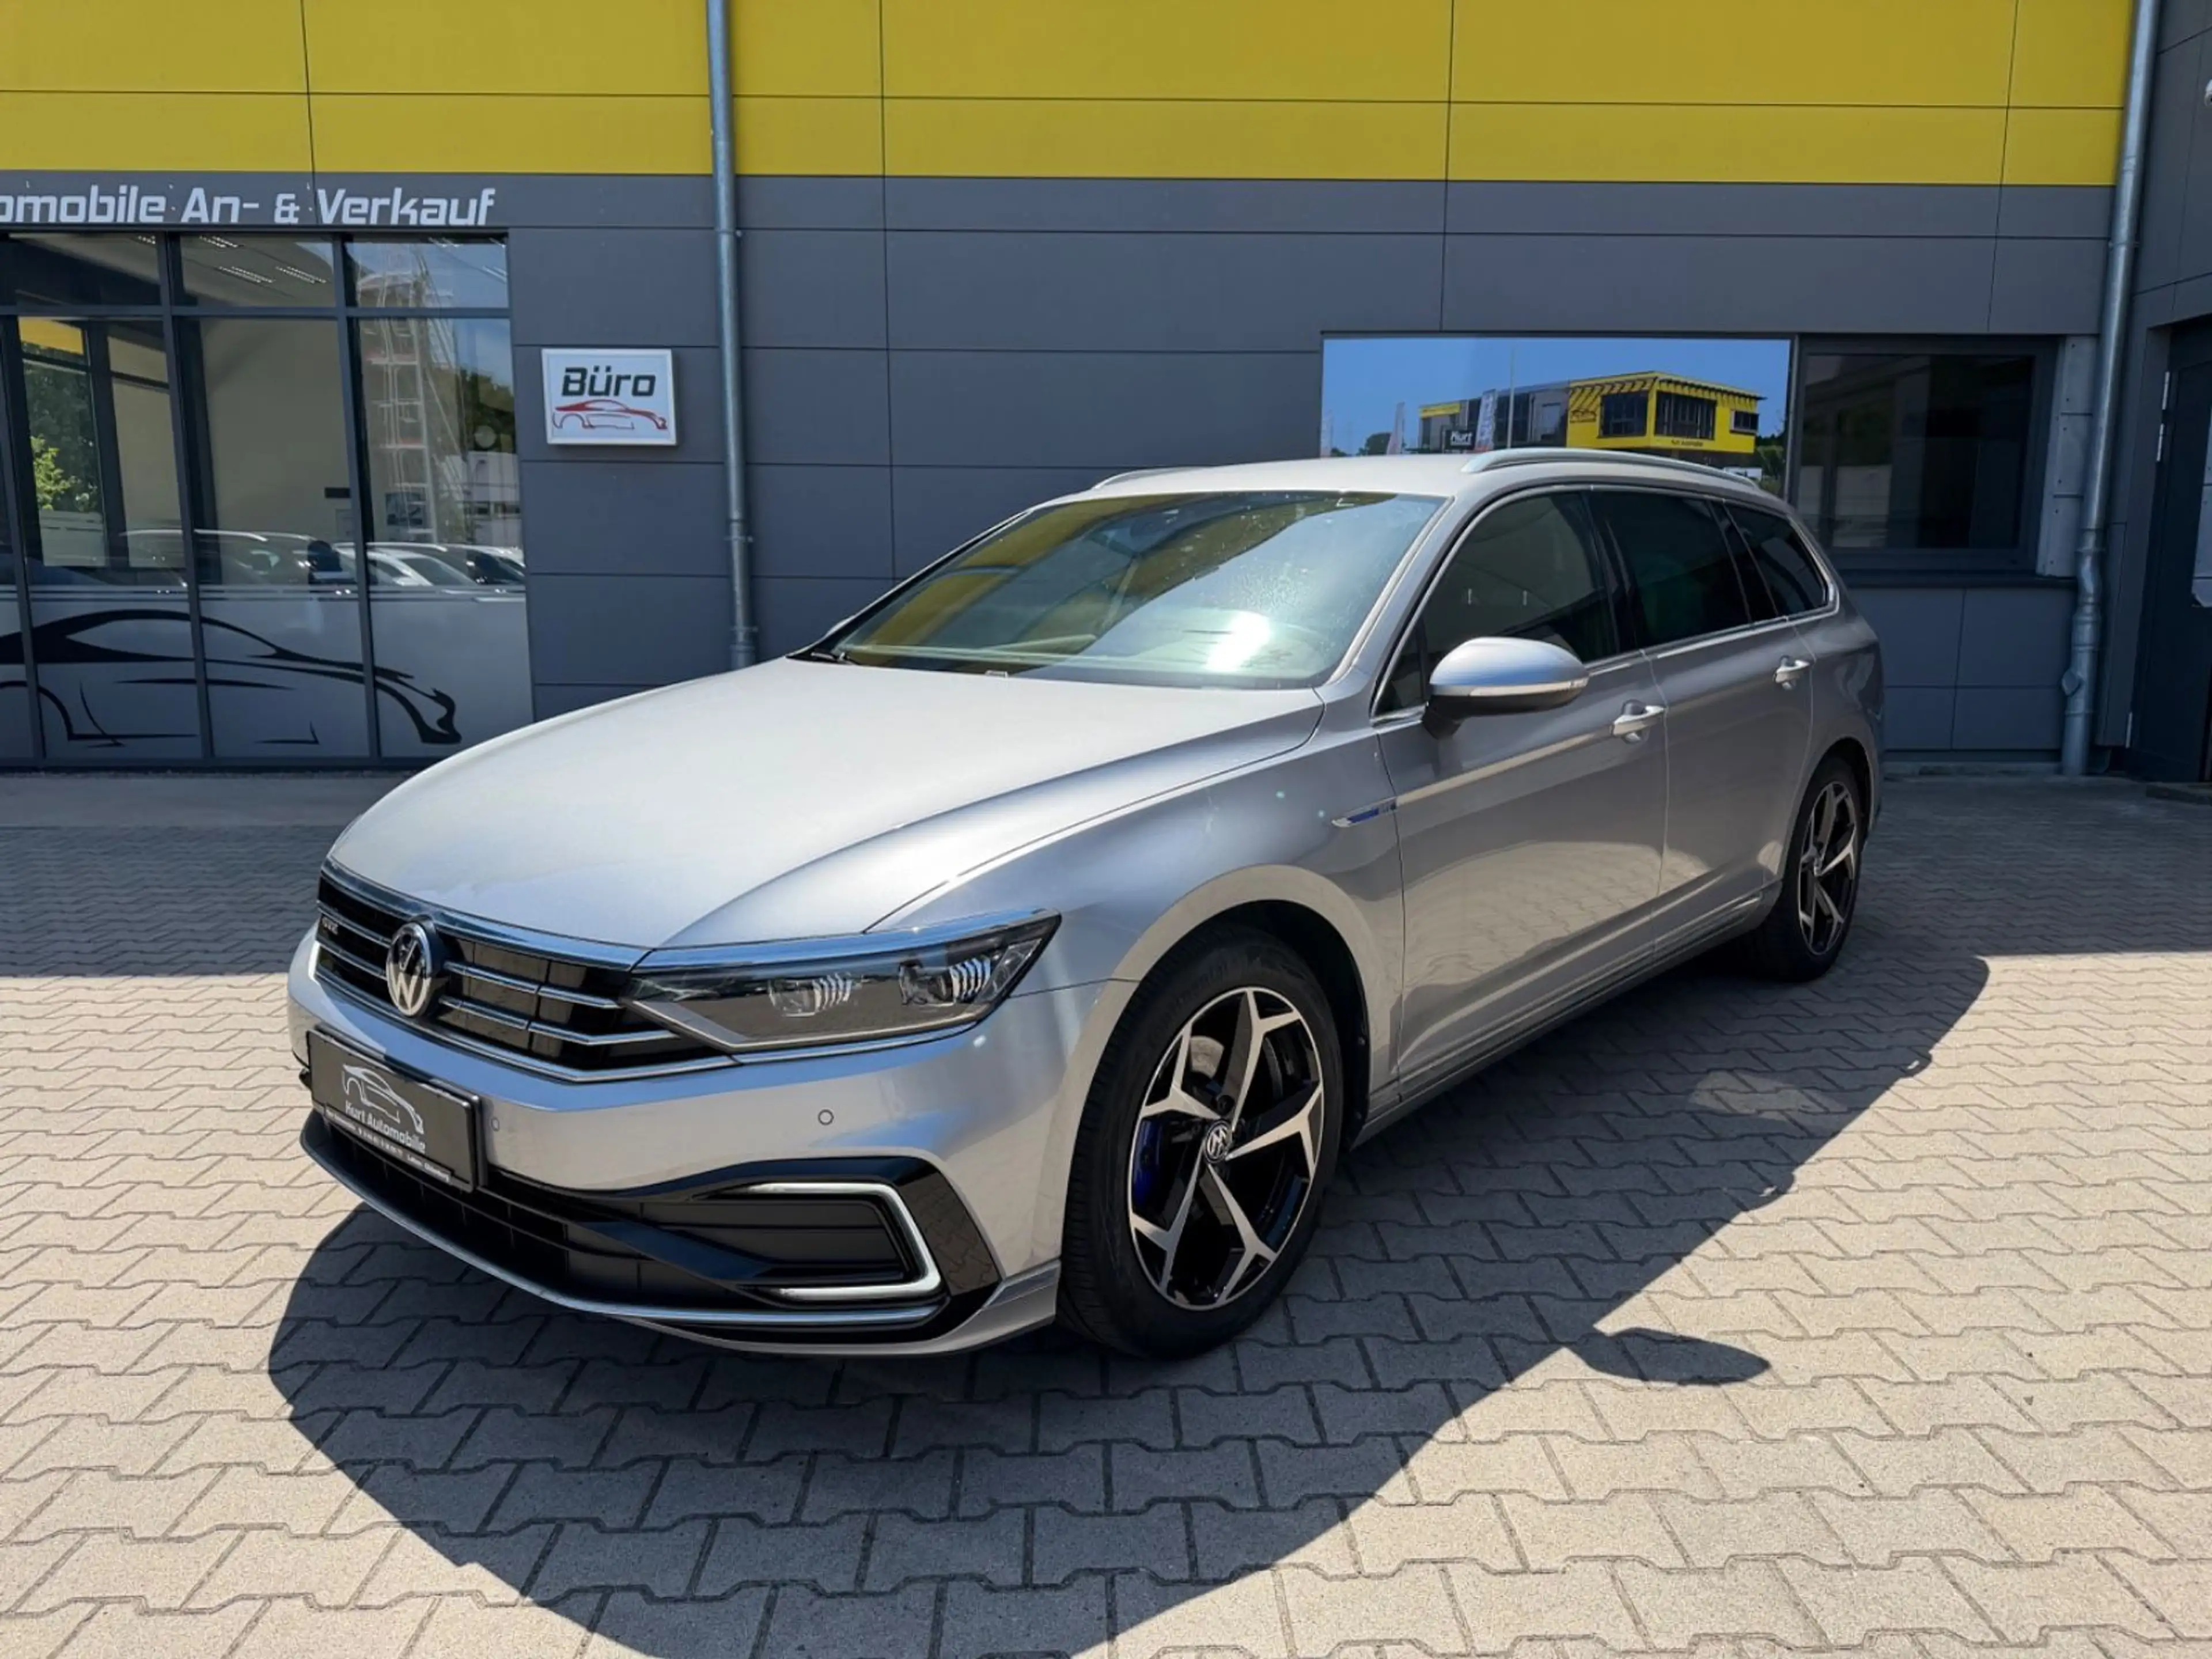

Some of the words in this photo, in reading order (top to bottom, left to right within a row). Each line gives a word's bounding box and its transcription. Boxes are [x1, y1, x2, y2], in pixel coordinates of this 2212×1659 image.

[181, 187, 260, 223] An-
[274, 193, 300, 224] &
[317, 187, 496, 225] Verkauf
[561, 365, 656, 397] Büro
